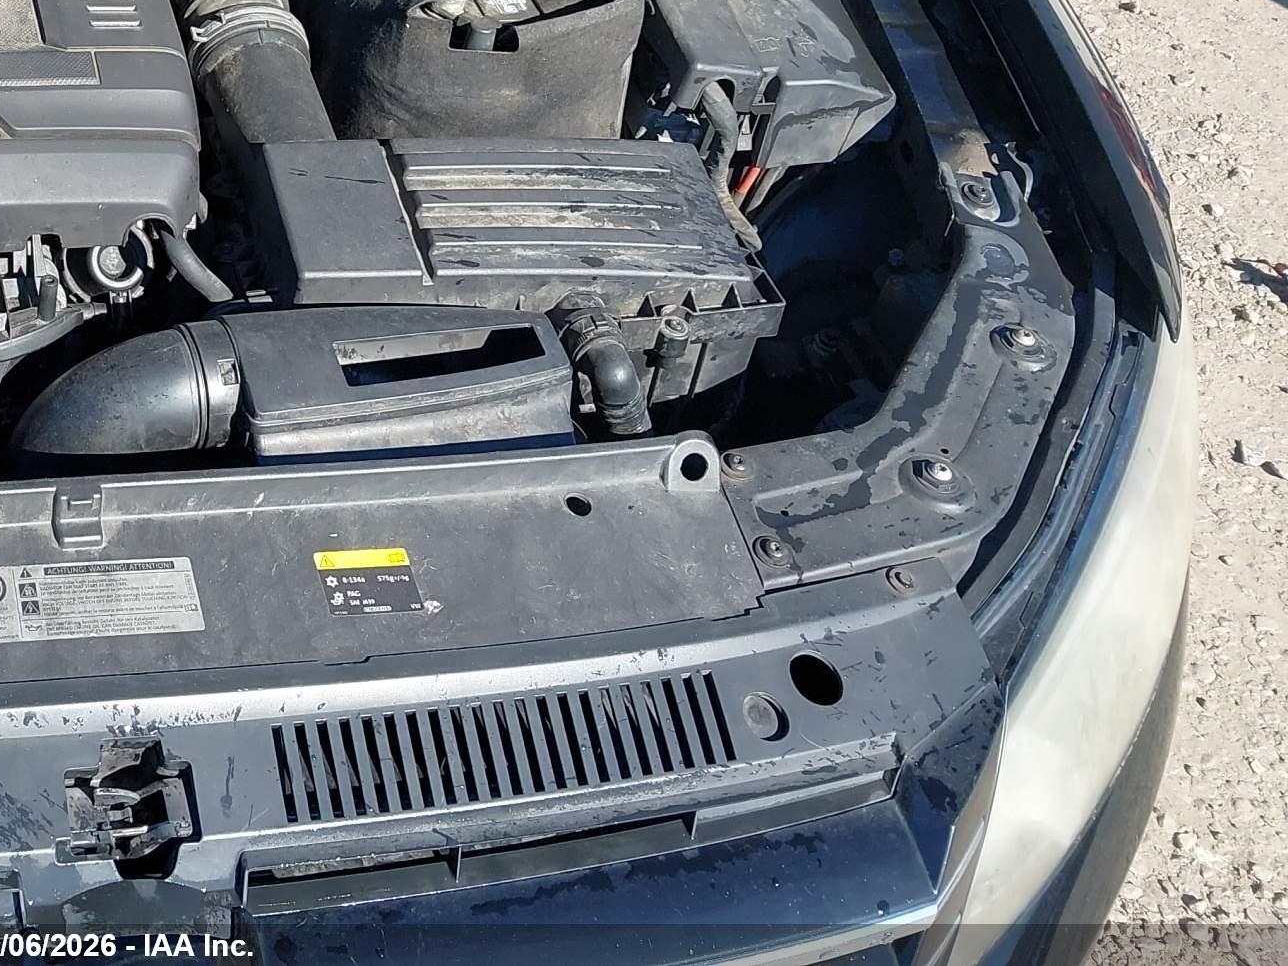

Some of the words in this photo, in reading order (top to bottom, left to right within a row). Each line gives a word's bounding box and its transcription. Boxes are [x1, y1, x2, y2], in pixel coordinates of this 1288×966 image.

[47, 566, 88, 575] ACHTUNG!
[89, 563, 127, 572] WARNING!
[129, 561, 173, 570] ATTENTION!
